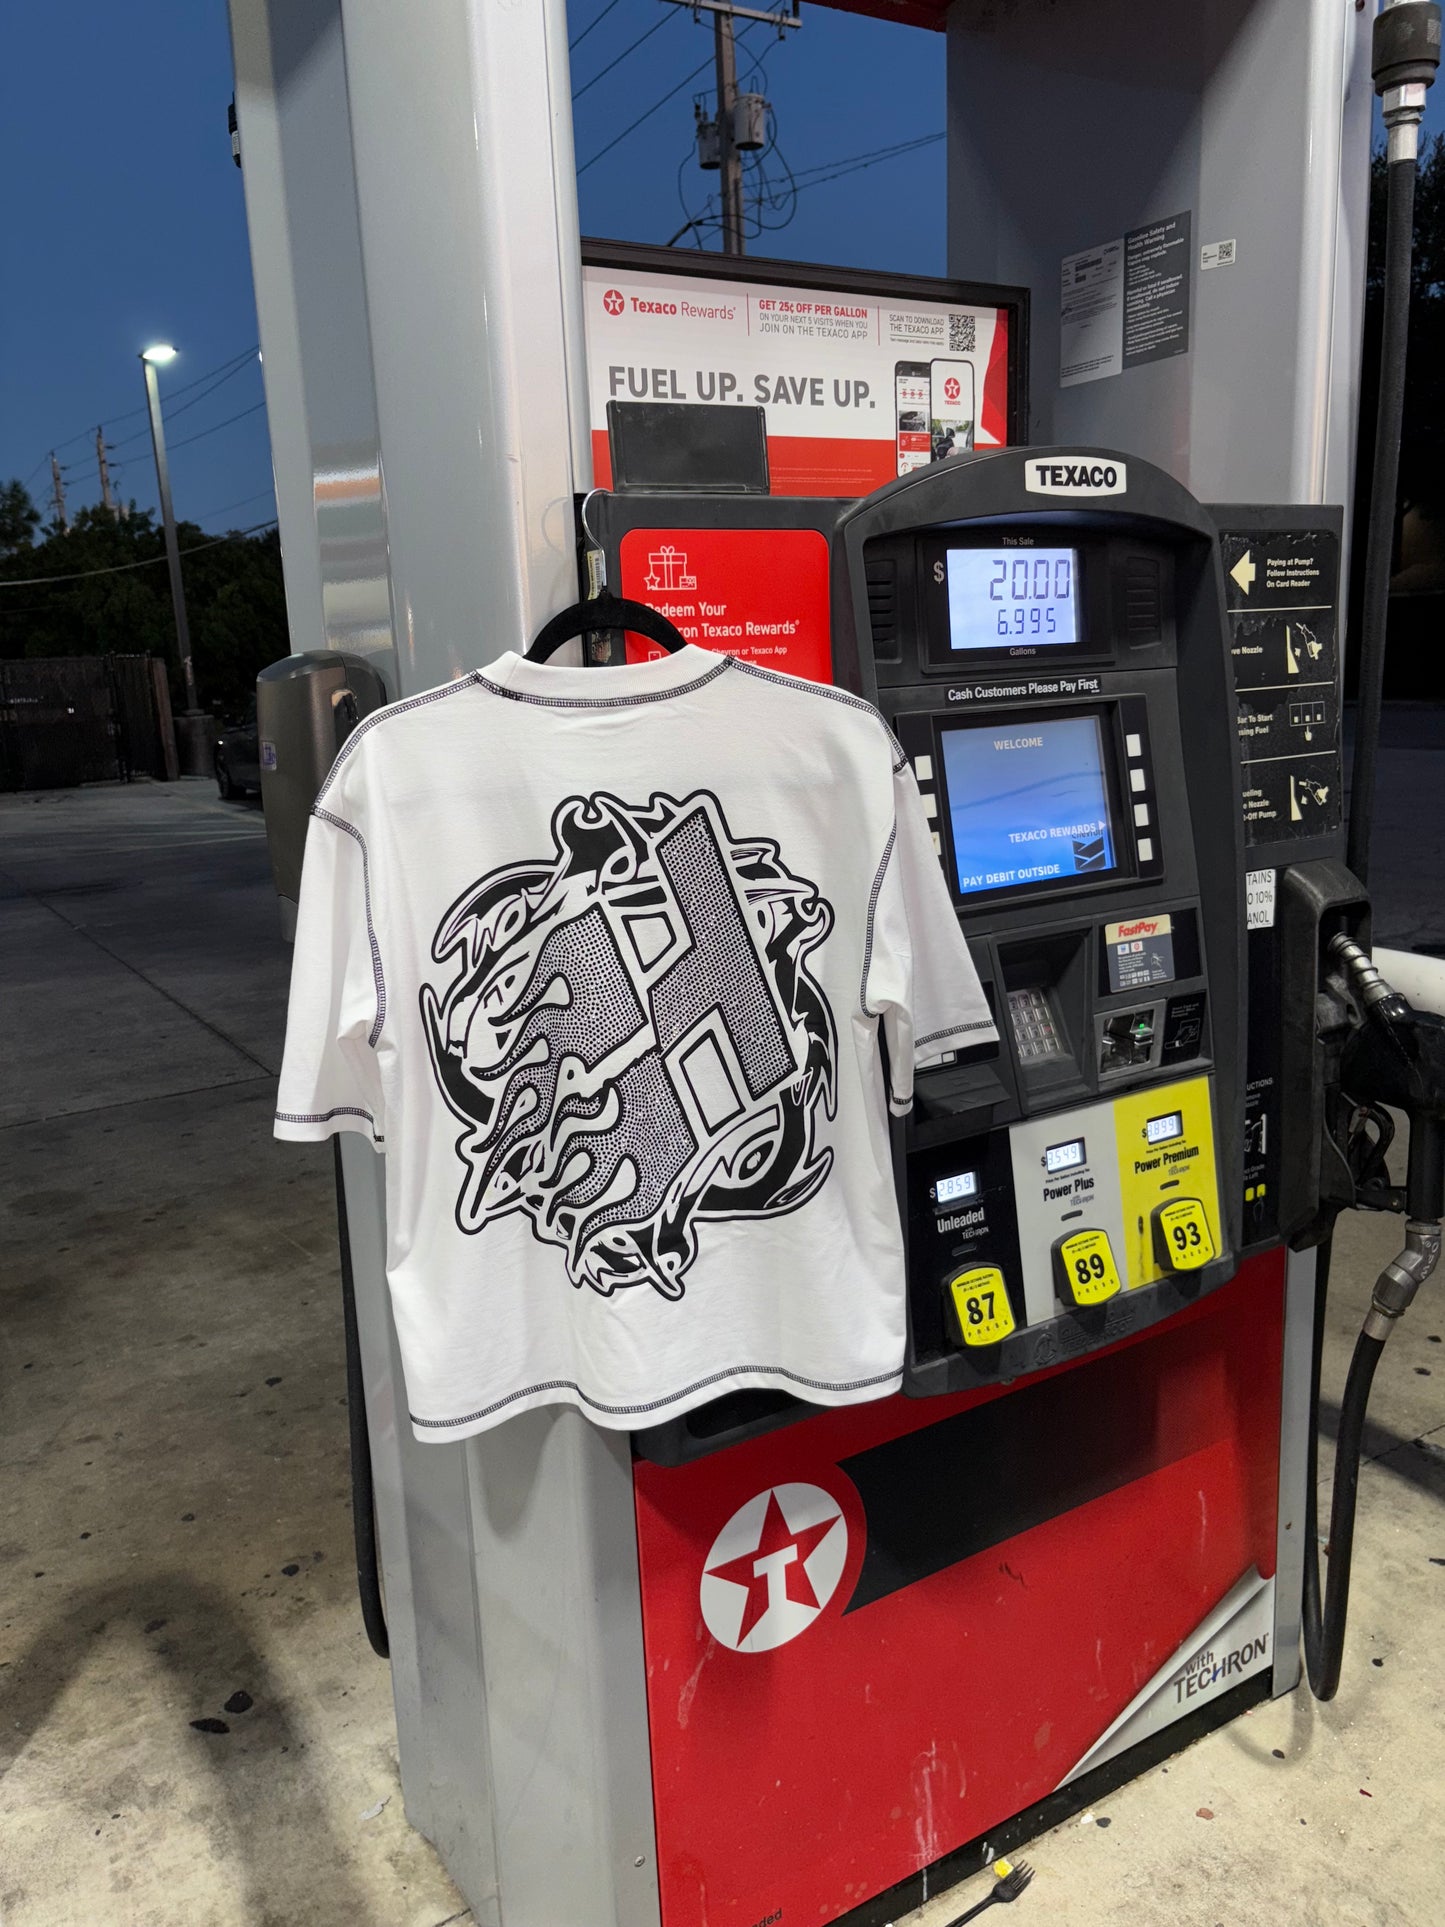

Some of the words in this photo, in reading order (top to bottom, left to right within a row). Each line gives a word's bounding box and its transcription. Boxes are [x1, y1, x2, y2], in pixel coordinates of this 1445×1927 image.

[631, 297, 677, 315] Texaco
[681, 302, 735, 320] Rewards
[759, 299, 777, 310] GET
[779, 302, 794, 314] 25¢
[796, 303, 812, 314] OFF
[815, 305, 832, 316] PER
[834, 306, 868, 319] GALLON
[760, 313, 770, 321] ON
[771, 314, 789, 323] YOUR
[790, 315, 806, 325] NEXT
[808, 317, 812, 325] 5
[813, 317, 834, 327] VISITS
[835, 319, 854, 328] WHEN
[855, 321, 868, 329] YOU
[889, 314, 905, 322] SCAN
[914, 316, 945, 326] DOWNLOAD
[760, 323, 780, 333] JOIN
[783, 324, 794, 334] ON
[798, 326, 814, 336] THE
[816, 328, 849, 339] TEXACO
[851, 330, 868, 340] APP
[890, 323, 903, 332] THE
[904, 324, 930, 334] TEXACO
[931, 327, 944, 335] APP
[608, 365, 687, 400] FUEL
[696, 371, 744, 402] UP.
[754, 374, 825, 407] SAVE
[833, 379, 876, 409] UP.
[1036, 465, 1117, 488] TEXACO
[1003, 538, 1018, 546] This
[1019, 537, 1034, 546] Sale
[1267, 559, 1286, 567] Paying
[1295, 558, 1314, 566] Pump?
[933, 561, 945, 584] $
[990, 559, 1071, 601] 20.00
[1287, 569, 1320, 577] Instructions
[698, 602, 727, 616] Your
[998, 608, 1056, 635] 6.995
[702, 623, 742, 637] Texaco
[750, 647, 773, 655] Texaco
[774, 646, 788, 655] App
[1010, 647, 1036, 657] Gallons
[1242, 646, 1263, 654] Nozzle
[948, 688, 973, 701] Cash
[975, 685, 1027, 699] Customers
[1028, 682, 1059, 695] Please
[1060, 680, 1077, 693] Pay
[1078, 679, 1099, 691] First
[1248, 715, 1256, 723] To
[1257, 714, 1273, 722] Start
[1255, 725, 1269, 734] Fuel
[994, 737, 1044, 751] WELCOME
[1248, 799, 1270, 809] Nozzle
[1259, 811, 1277, 820] Pump
[1008, 830, 1047, 844] TEXACO
[1050, 823, 1097, 838] REWARDS
[963, 876, 983, 888] PAY
[986, 870, 1016, 884] DEBIT
[1018, 864, 1061, 880] OUTSIDE
[1247, 871, 1272, 886] TAINS
[1256, 891, 1273, 904] 10%
[1118, 921, 1158, 938] FastPay
[1041, 1157, 1046, 1168] $
[1134, 1157, 1162, 1174] Power
[1163, 1146, 1200, 1166] Premium
[930, 1188, 936, 1199] $
[1043, 1184, 1072, 1202] Power
[1074, 1178, 1095, 1193] Plus
[937, 1206, 985, 1233] Unleaded
[1173, 1222, 1201, 1251] 93
[1075, 1253, 1105, 1285] 89
[966, 1291, 995, 1326] 87
[1174, 1634, 1268, 1704] TECHRON
[1185, 1651, 1214, 1676] with
